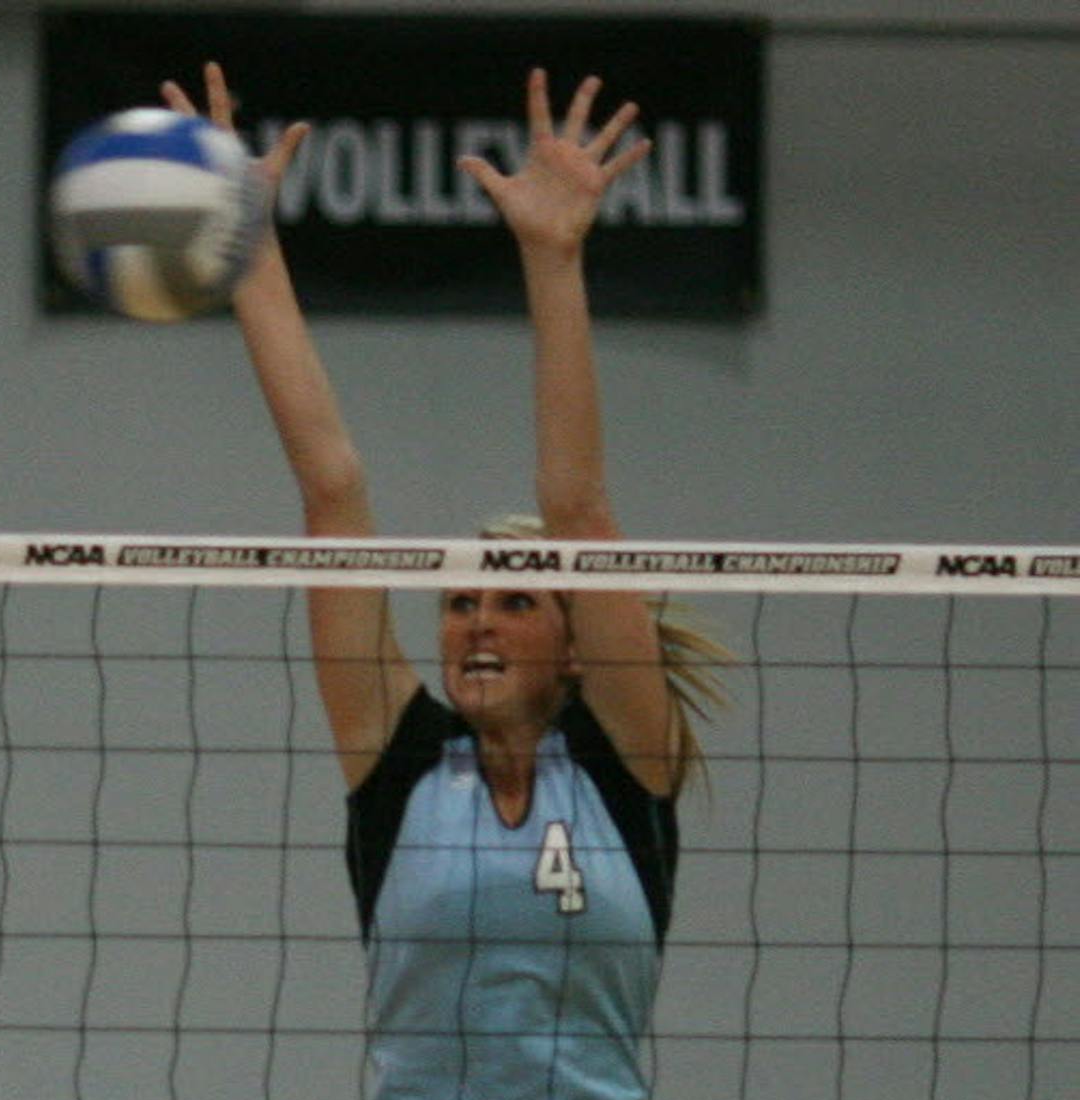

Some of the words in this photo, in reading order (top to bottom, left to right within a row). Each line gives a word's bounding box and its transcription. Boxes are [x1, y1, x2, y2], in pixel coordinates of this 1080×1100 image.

[265, 118, 745, 227] VOLLEALL
[24, 545, 107, 567] NCAA
[124, 548, 261, 568] VOLLEYBALL
[266, 549, 443, 570] CHAMPIONSHIP
[479, 550, 562, 573] NCAA
[578, 552, 717, 572] VOLLEYBALL
[722, 552, 897, 574] CHAMPIONSHIP
[935, 555, 1017, 577] NCAA
[533, 820, 586, 915] 4
